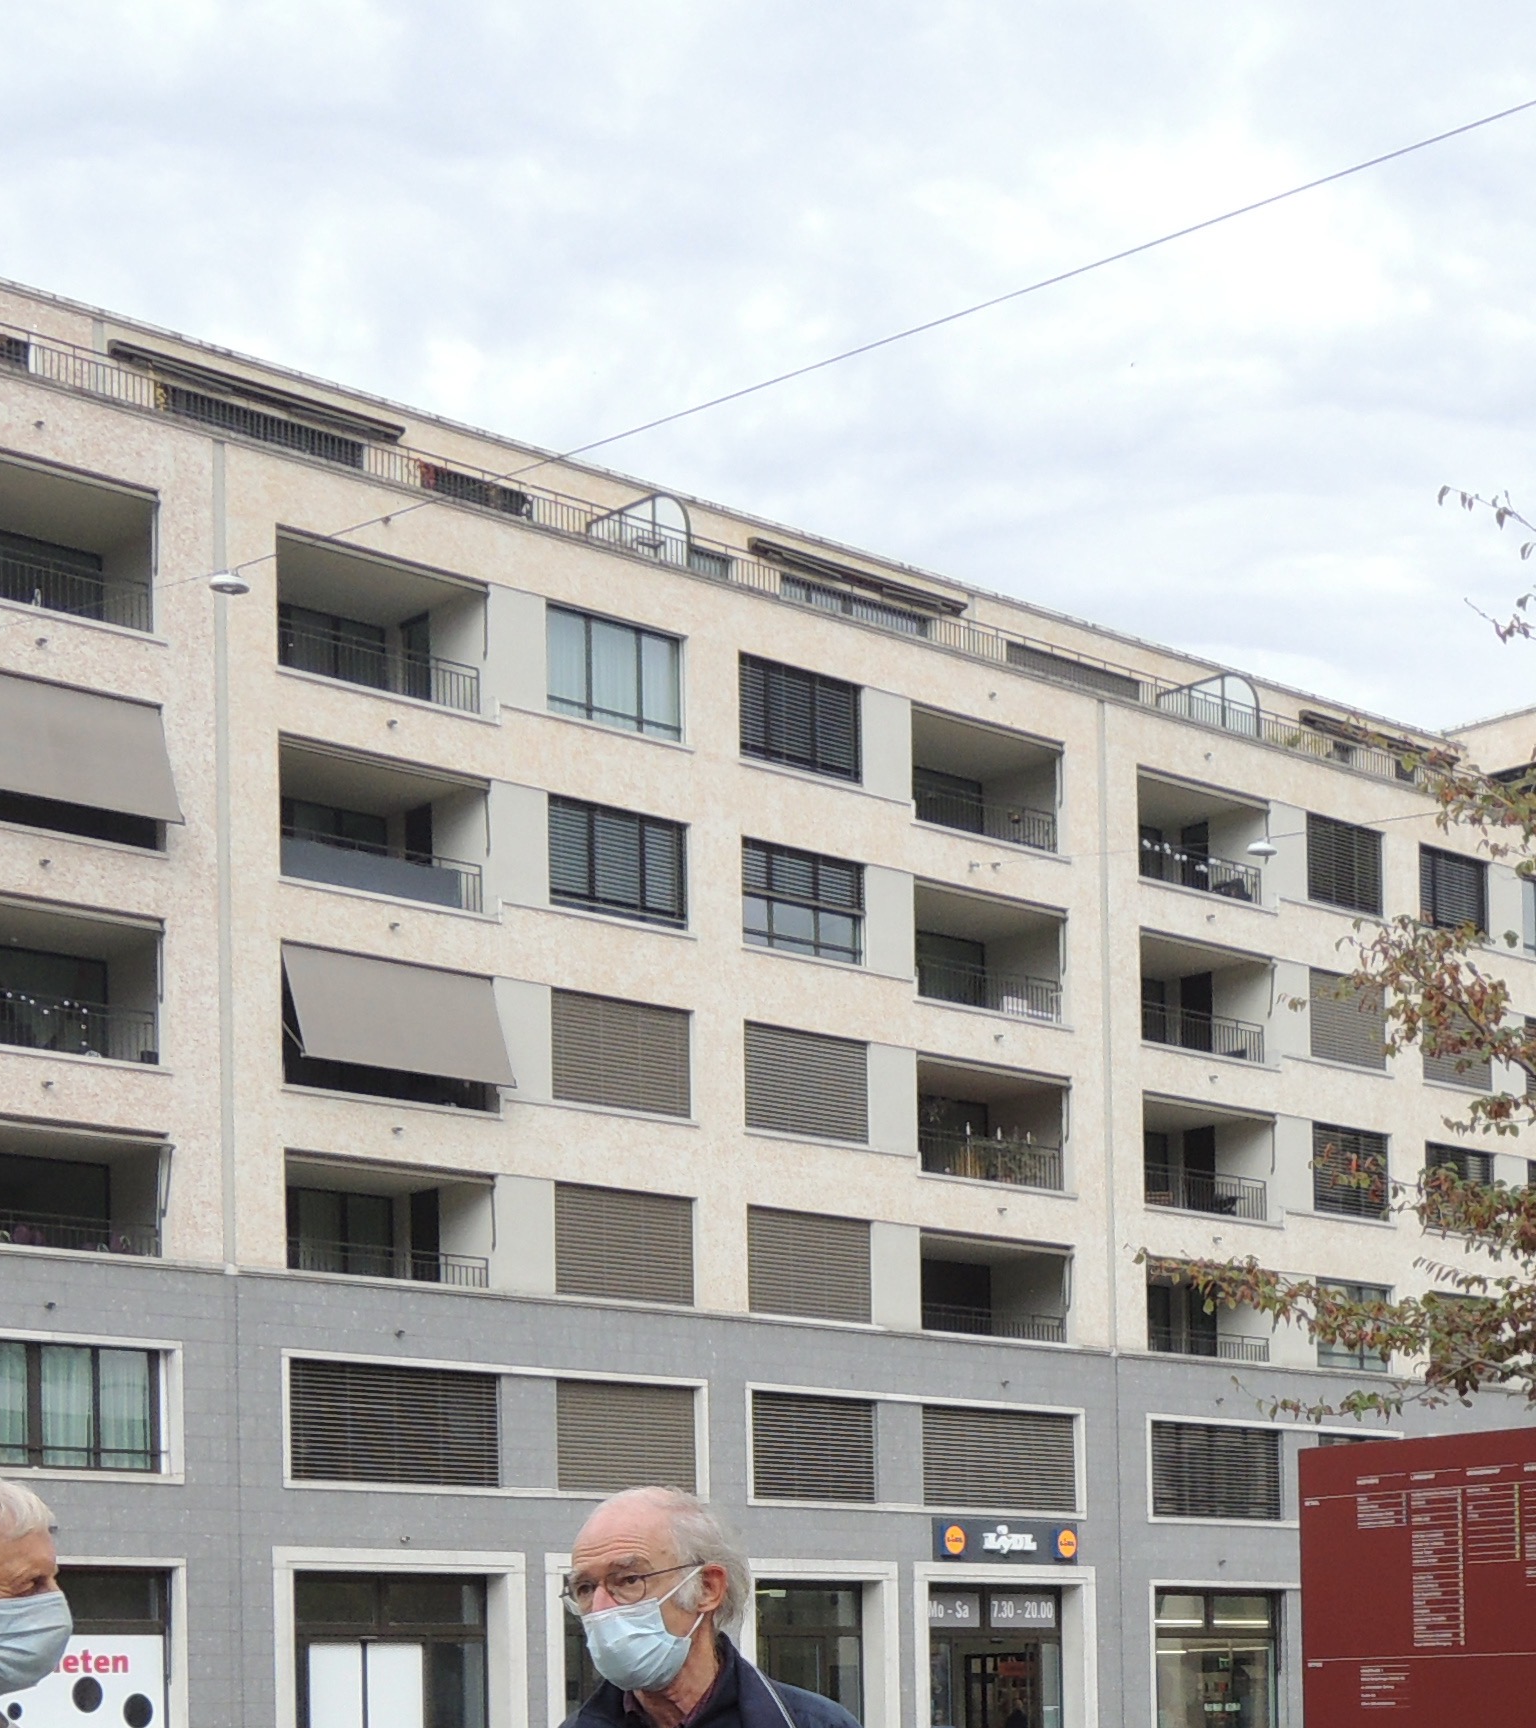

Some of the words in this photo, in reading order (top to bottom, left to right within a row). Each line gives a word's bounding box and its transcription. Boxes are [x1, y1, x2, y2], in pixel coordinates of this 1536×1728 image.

[928, 1600, 944, 1618] Mo
[955, 1600, 969, 1619] Sa
[991, 1601, 1014, 1618] 7.30
[1024, 1601, 1054, 1619] 20.00
